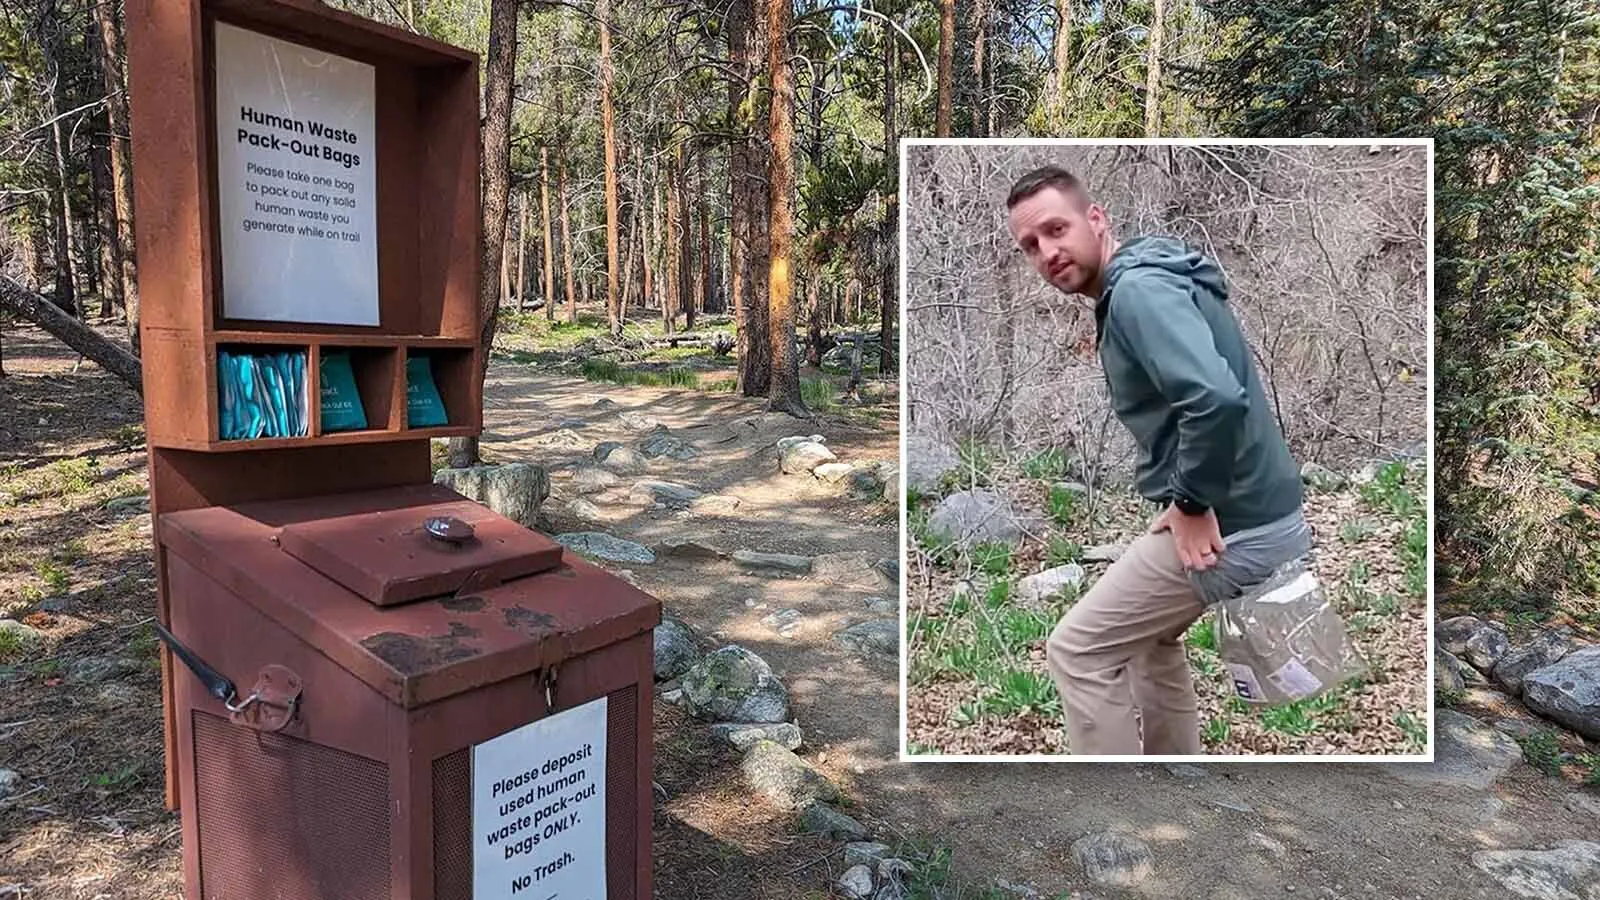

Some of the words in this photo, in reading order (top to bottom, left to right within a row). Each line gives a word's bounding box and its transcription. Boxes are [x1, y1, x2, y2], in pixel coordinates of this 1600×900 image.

[240, 106, 304, 133] Human
[308, 120, 357, 144] Waste
[238, 129, 320, 158] Pack-Out
[323, 146, 360, 168] Bags
[246, 181, 258, 192] to
[261, 184, 288, 196] pack
[292, 190, 308, 200] out
[311, 193, 330, 206] any
[333, 196, 356, 208] solid
[247, 162, 284, 178] Please
[287, 170, 310, 183] take
[312, 175, 332, 186] one
[334, 179, 354, 193] bag
[242, 219, 295, 234] generate
[298, 226, 324, 238] while
[326, 230, 340, 239] on
[342, 231, 360, 242] trail
[255, 200, 295, 216] human
[298, 208, 328, 220] waste
[331, 213, 350, 224] you
[492, 768, 538, 798] Please
[542, 744, 592, 773] deposit
[500, 789, 534, 816] used
[538, 769, 585, 800] human
[487, 816, 531, 845] waste
[534, 784, 596, 828] pack-out
[505, 834, 540, 860] bags
[544, 812, 581, 839] ONLY.
[512, 876, 531, 894] No
[534, 852, 575, 881] Trash.
